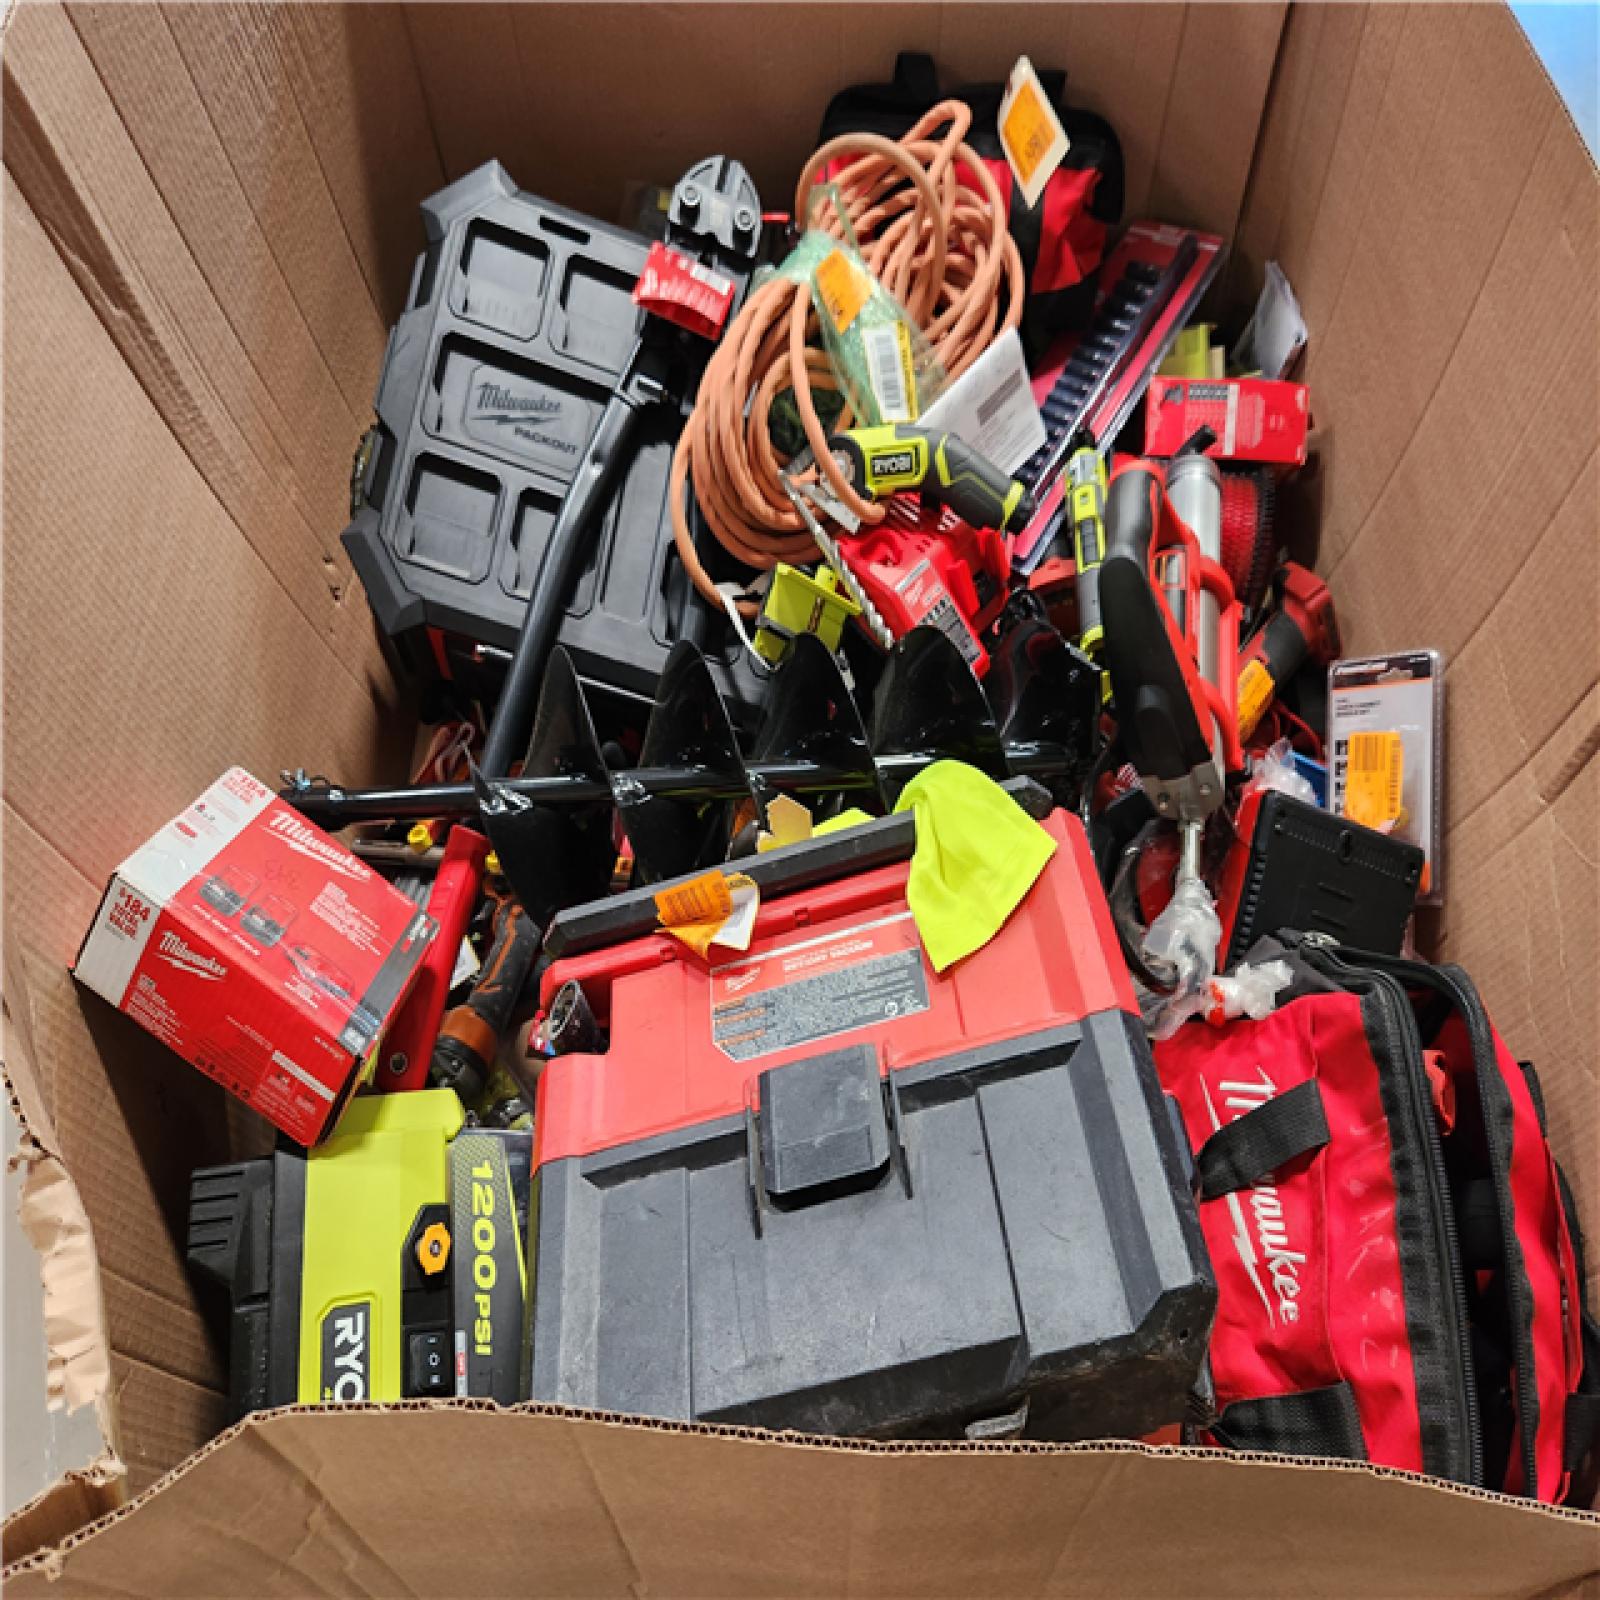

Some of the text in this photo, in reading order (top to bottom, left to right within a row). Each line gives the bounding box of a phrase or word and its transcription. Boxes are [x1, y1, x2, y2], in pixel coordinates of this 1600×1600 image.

[477, 382, 561, 412] Milwaukee
[514, 426, 576, 456] PACKOUT
[872, 455, 911, 474] RYOBI
[269, 809, 371, 880] Milwaukee
[160, 930, 228, 977] Milwaukee
[471, 1160, 497, 1356] 1200PSI
[334, 1311, 365, 1403] RYO
